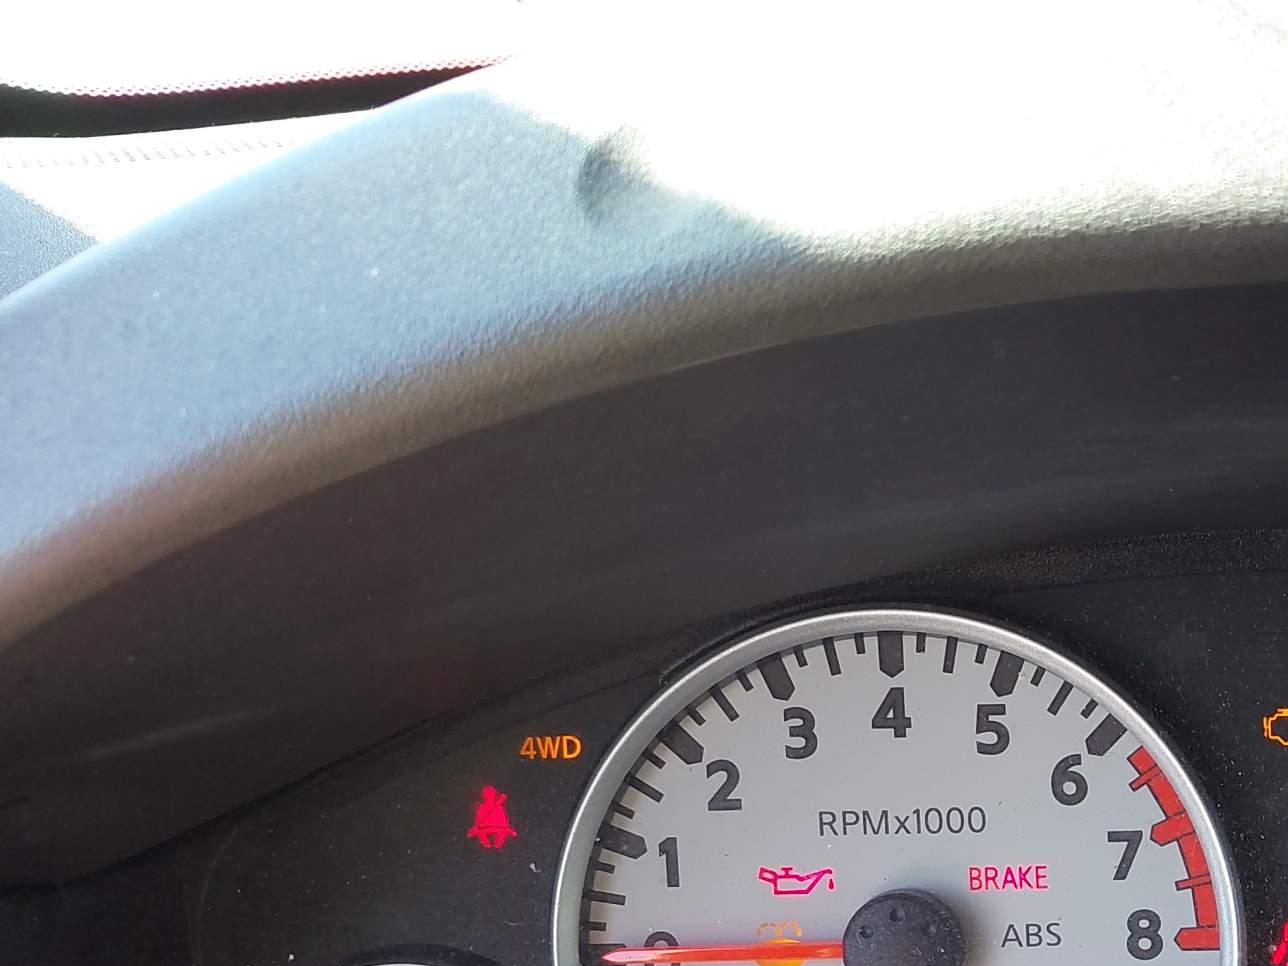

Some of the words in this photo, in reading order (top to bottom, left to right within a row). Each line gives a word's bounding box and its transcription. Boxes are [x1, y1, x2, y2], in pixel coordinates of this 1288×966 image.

[784, 708, 818, 759] 3
[872, 687, 911, 738] 4
[975, 704, 1010, 755] 5
[520, 736, 582, 760] 4WD
[707, 759, 742, 811] 2
[1051, 754, 1088, 806] 6
[818, 806, 987, 836] RPMx1000
[658, 837, 680, 887] 1
[968, 865, 1049, 890] BRAKE
[1107, 831, 1143, 881] 7
[1001, 923, 1062, 948] ABS
[1126, 909, 1163, 961] 8
